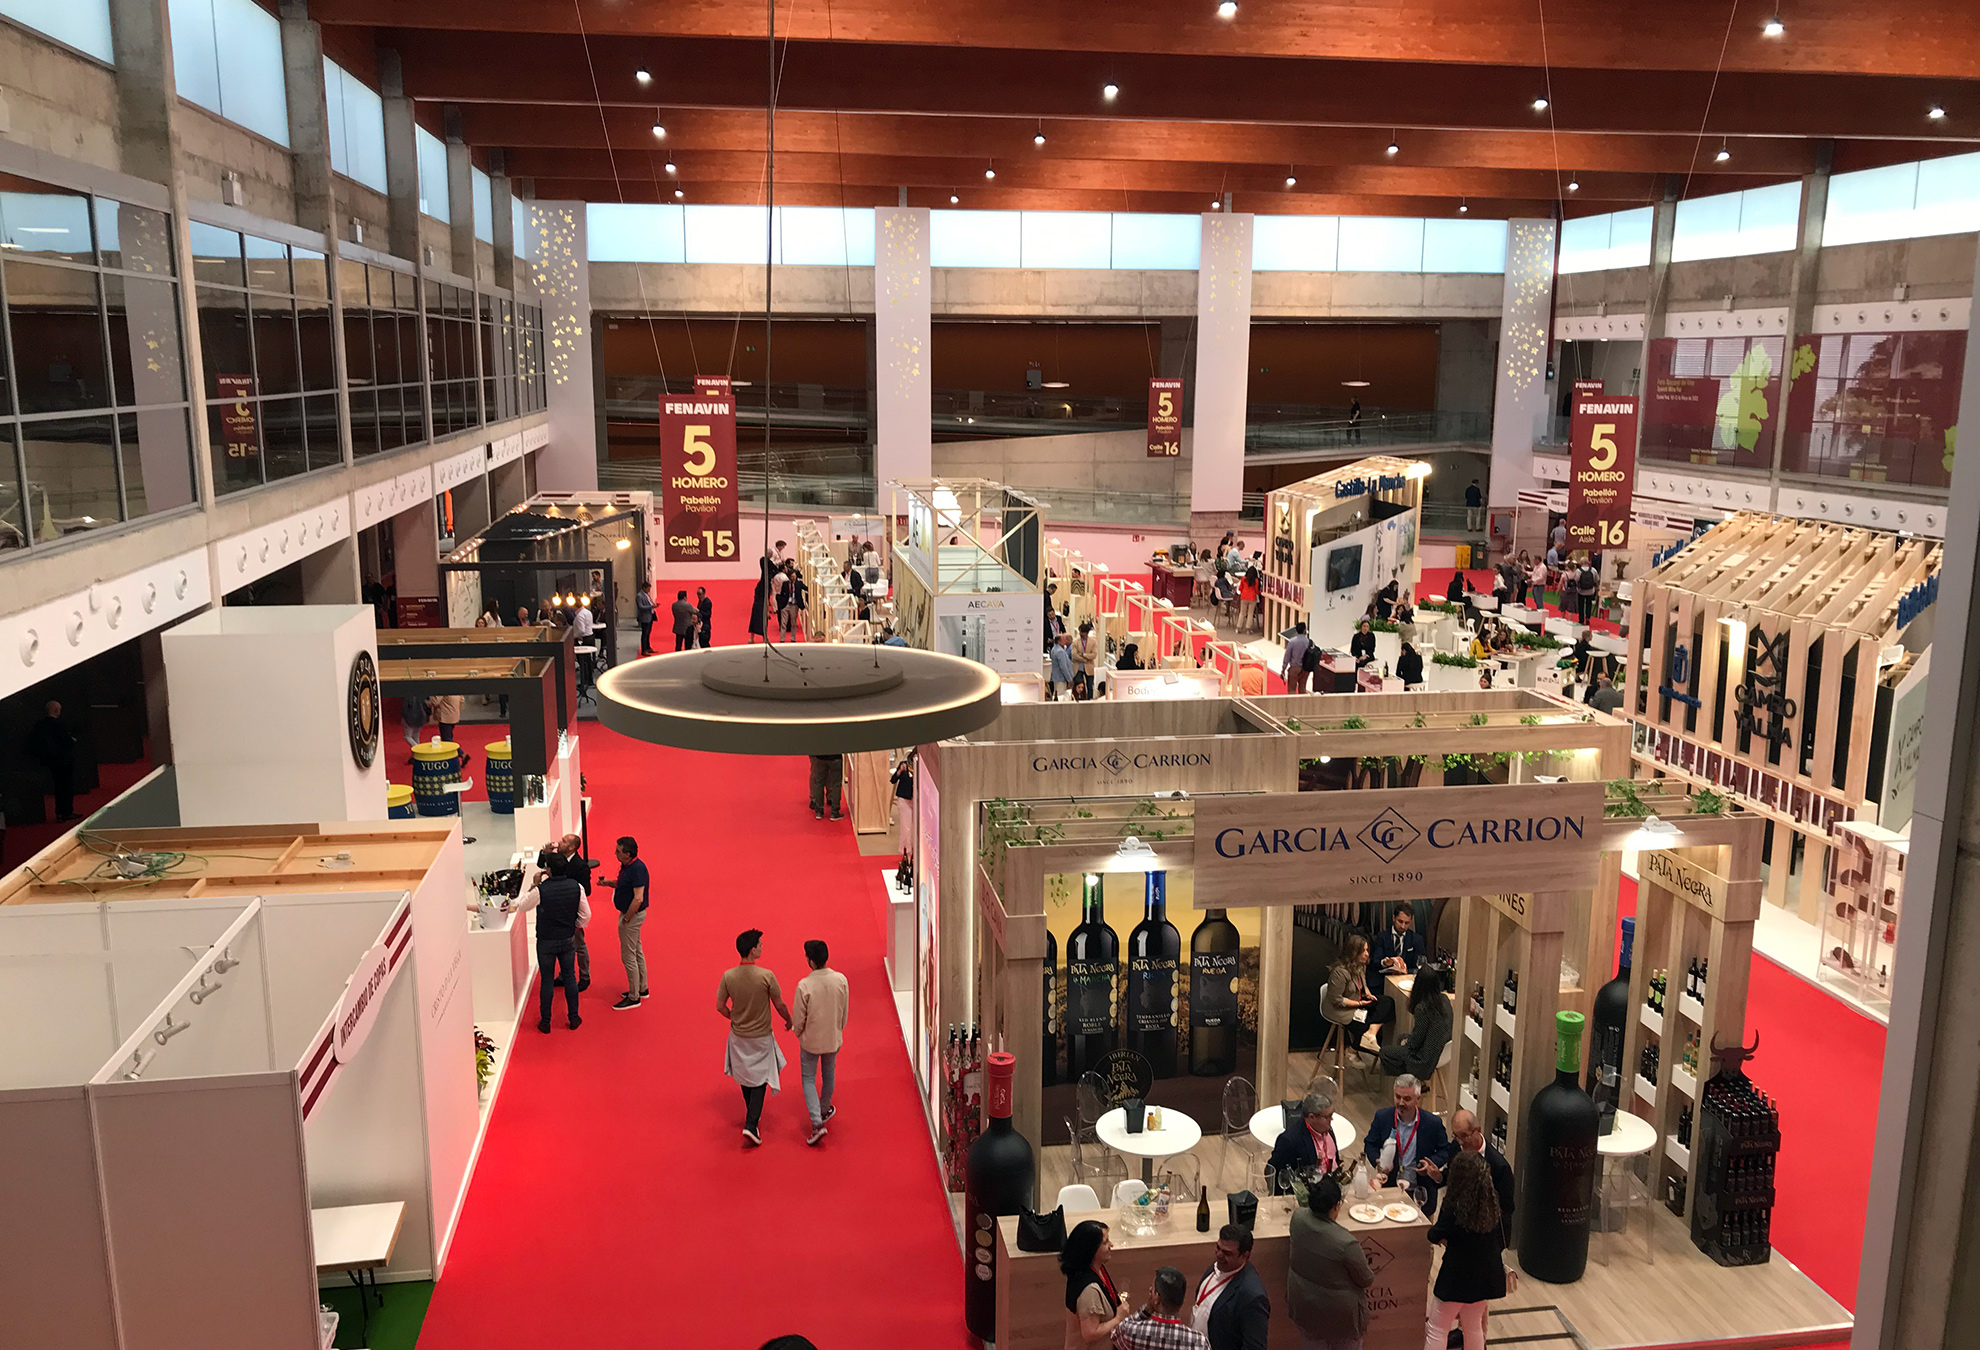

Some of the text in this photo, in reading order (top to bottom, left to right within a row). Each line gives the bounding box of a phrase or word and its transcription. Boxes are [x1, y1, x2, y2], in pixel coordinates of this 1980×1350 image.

[665, 403, 729, 415] FENAVIN
[1158, 392, 1173, 417] 5
[1579, 403, 1633, 414] FENAVIN
[683, 425, 716, 476] 5
[1164, 441, 1179, 455] 16
[1588, 424, 1617, 471] 5
[1577, 471, 1625, 482] HOMERO
[672, 477, 728, 489] HOMERO
[1583, 488, 1617, 497] Pabellón
[680, 495, 721, 504] Pabellón
[685, 505, 717, 513] Pavilion
[1570, 525, 1596, 536] Calle
[1598, 520, 1625, 546] 16
[669, 535, 700, 547] Calle
[702, 530, 735, 557] 15
[681, 547, 700, 555] Aisle
[968, 601, 1005, 609] AECAVA
[1735, 684, 1797, 719] CAMPO
[421, 761, 450, 771] YUGO
[1032, 756, 1097, 772] GARCIA
[1134, 753, 1211, 769] CARRION
[1215, 827, 1351, 858] GARCIA
[1427, 815, 1584, 849] CARRION
[1350, 871, 1423, 885] SINCE 1890
[1649, 853, 1714, 907] PATA NEGRA
[1132, 959, 1150, 971] PATA
[1194, 955, 1211, 967] PATA
[1070, 963, 1088, 975] PATA
[1202, 967, 1227, 975] RUEDA
[340, 957, 386, 1049] INTERCAMBIO DE COPAS
[1109, 1051, 1141, 1061] IBERIAN
[1111, 1060, 1132, 1072] PATA
[1107, 1072, 1138, 1084] NEGRA
